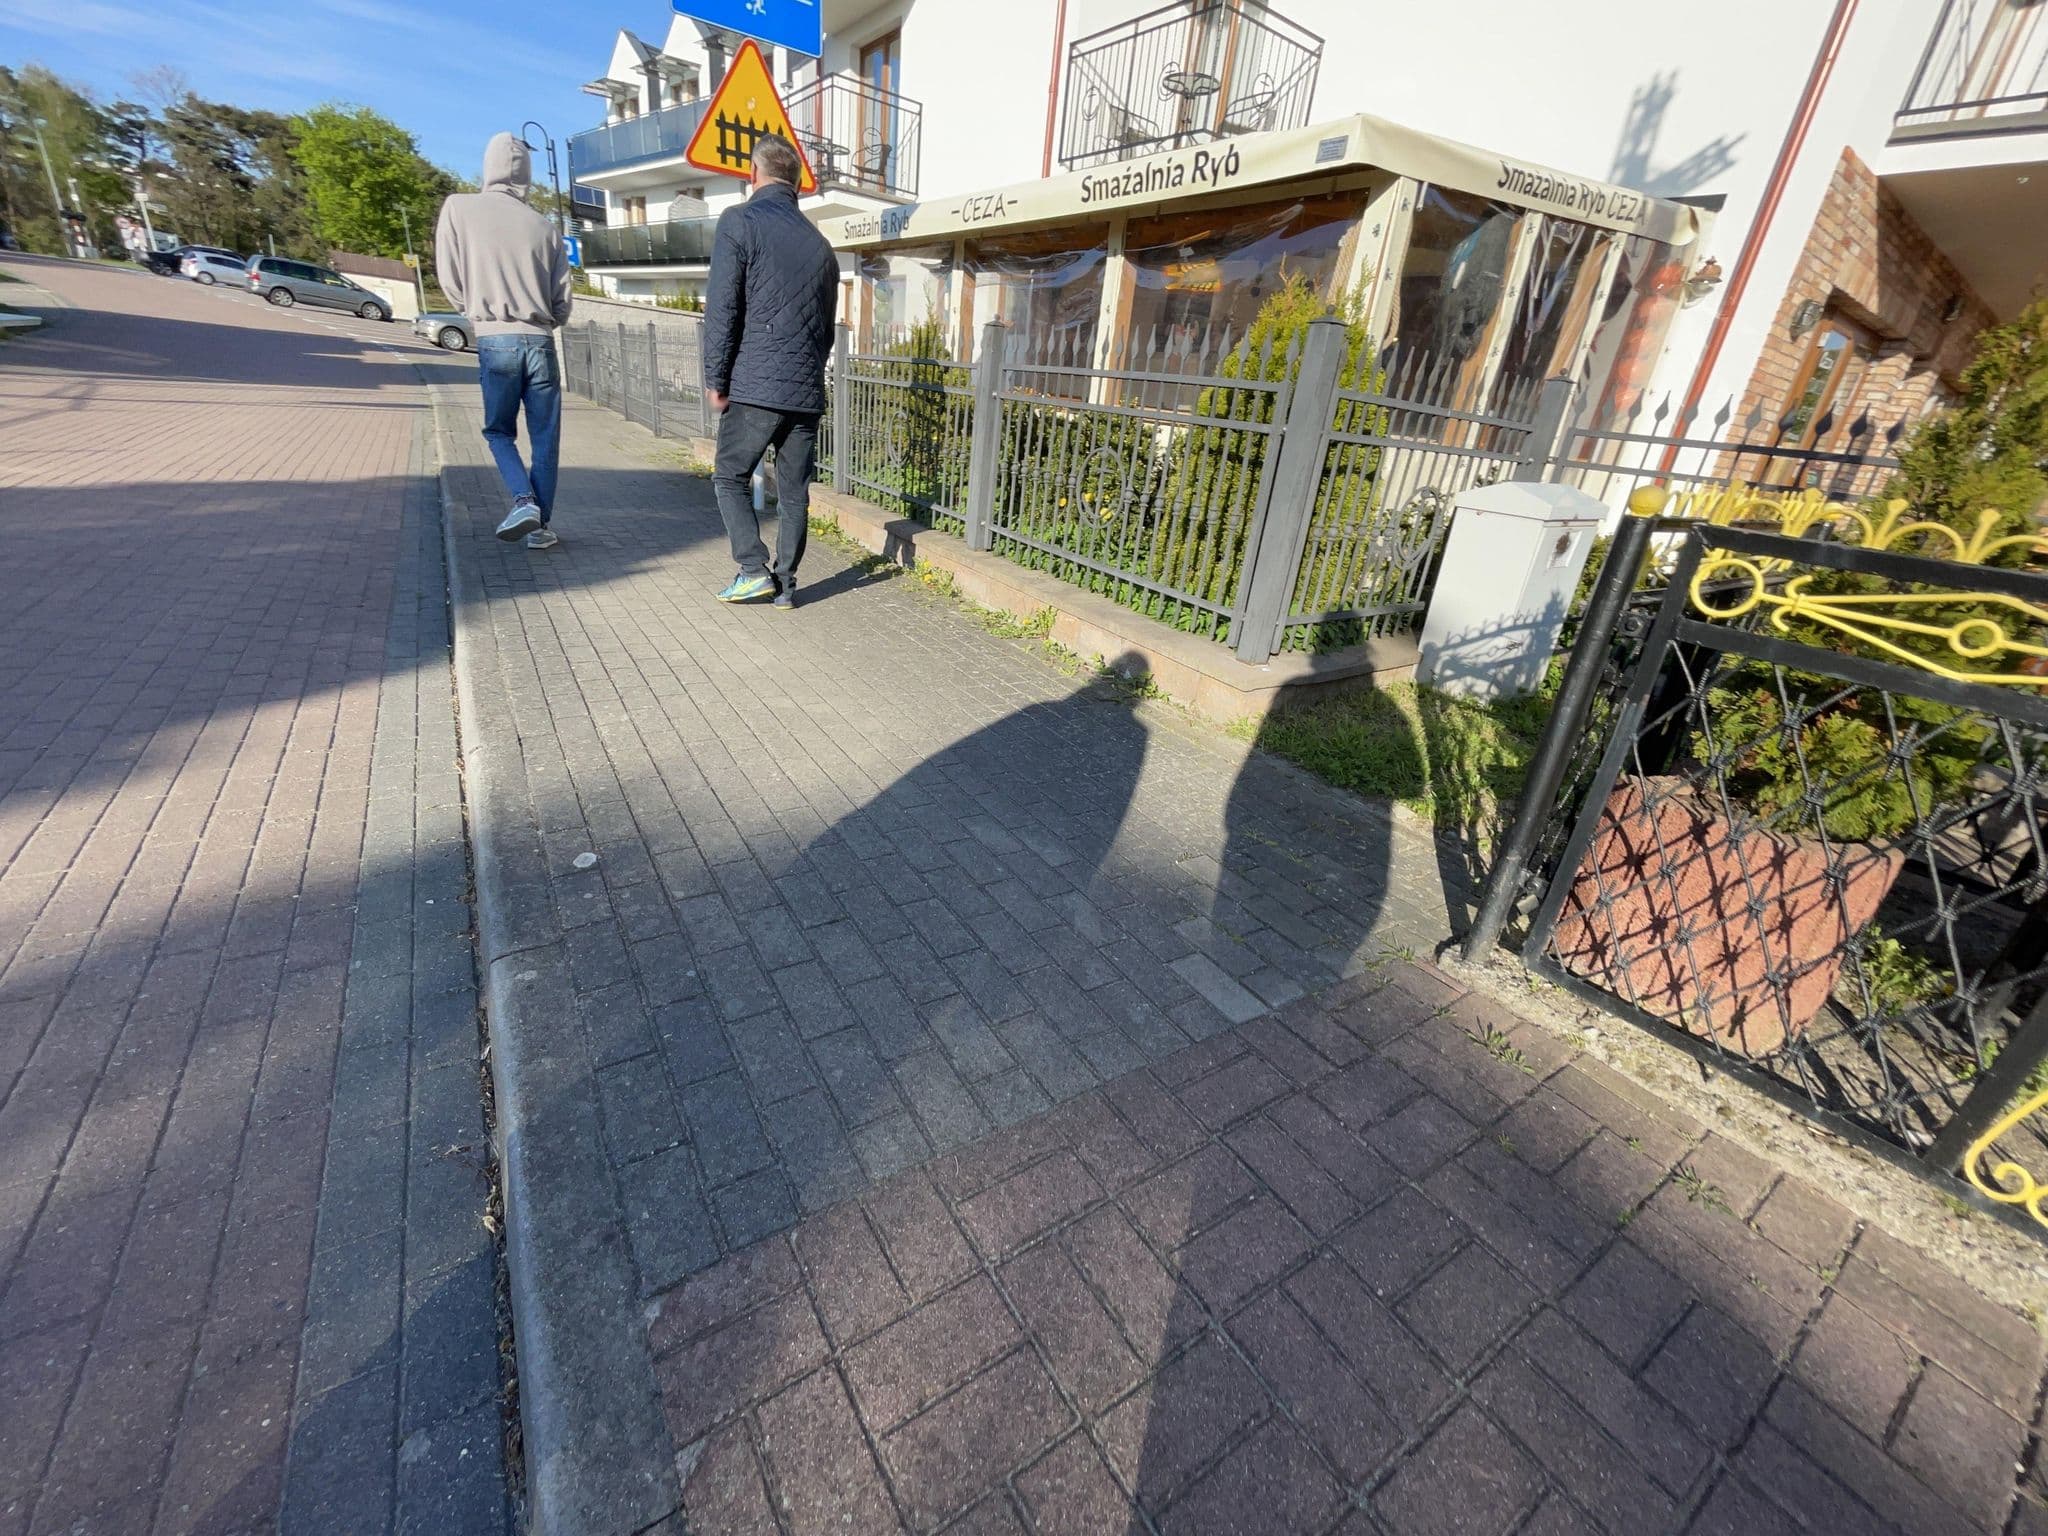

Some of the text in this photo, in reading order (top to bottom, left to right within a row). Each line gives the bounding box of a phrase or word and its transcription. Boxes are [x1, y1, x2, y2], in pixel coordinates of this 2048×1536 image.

[1081, 144, 1239, 203] Smażalnia Ryb
[1497, 160, 1646, 226] Smażalnia Ryb CEZA
[890, 210, 910, 236] Ryb
